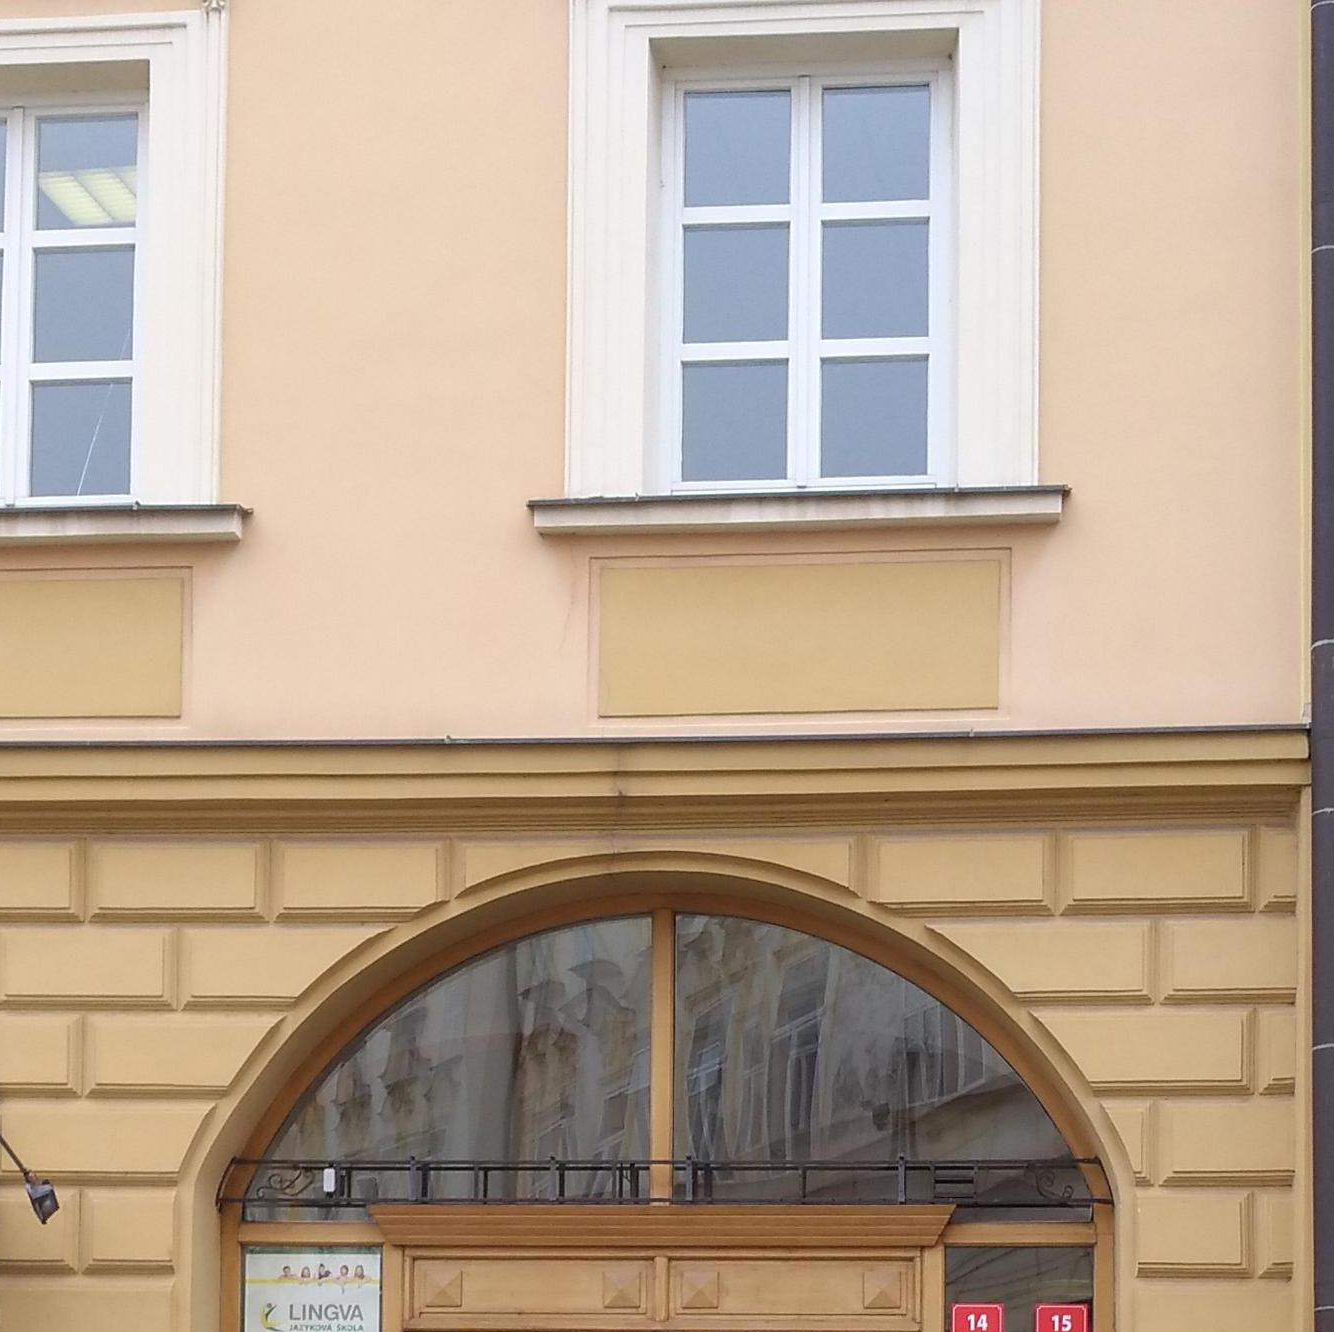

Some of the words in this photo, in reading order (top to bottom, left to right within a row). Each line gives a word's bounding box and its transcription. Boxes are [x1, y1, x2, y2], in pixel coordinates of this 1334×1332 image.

[288, 1303, 364, 1322] LINGVA
[288, 1323, 333, 1332] JAZYKOVÁ
[336, 1323, 364, 1332] ŠKOLA
[967, 1313, 988, 1331] 14
[1051, 1314, 1072, 1332] 15
